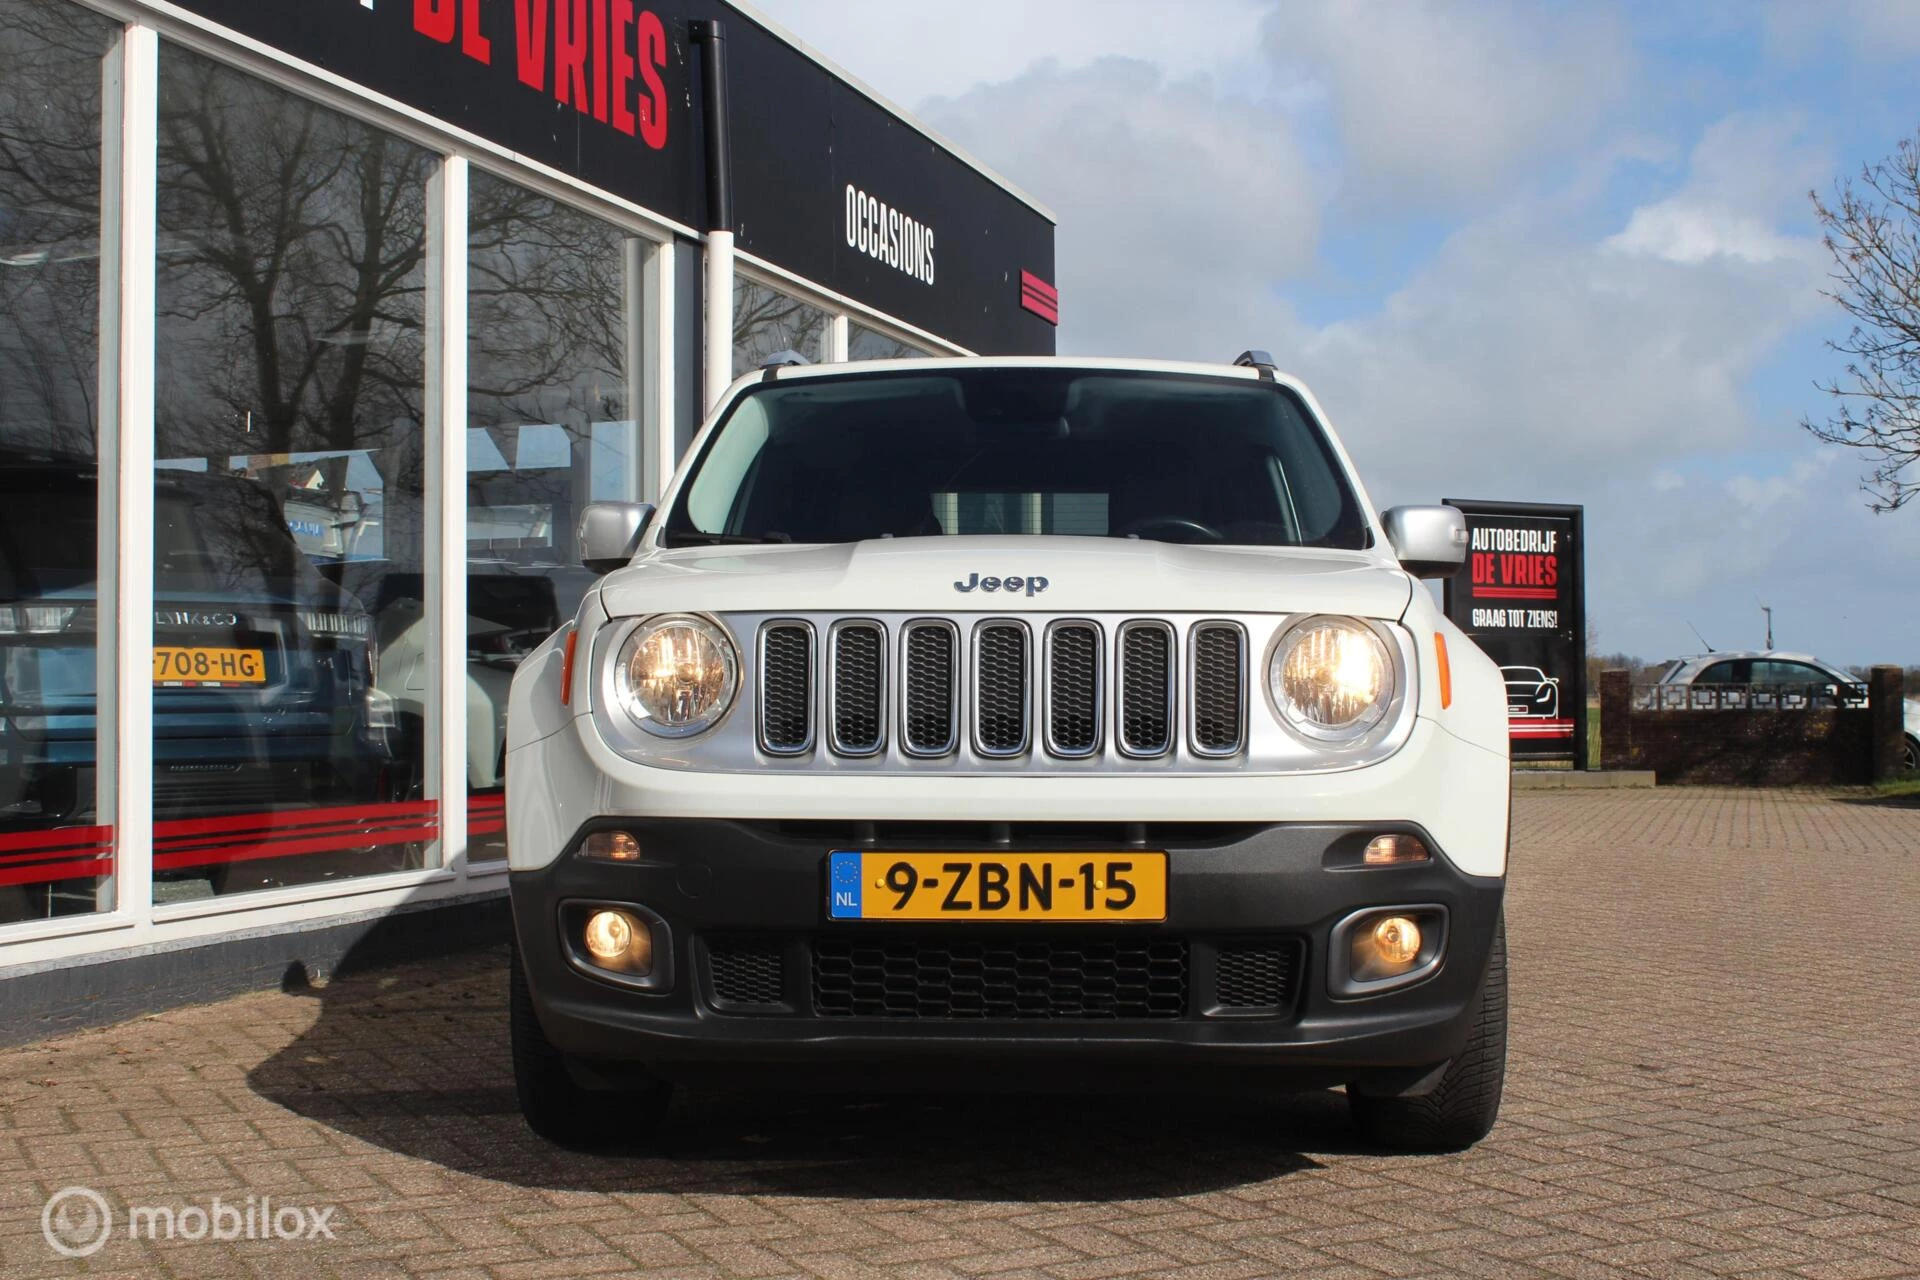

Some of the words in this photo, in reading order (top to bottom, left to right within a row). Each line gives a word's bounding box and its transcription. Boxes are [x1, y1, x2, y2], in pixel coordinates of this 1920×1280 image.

[514, 0, 668, 150] VRIES
[846, 184, 935, 286] OCCASIONS
[1472, 527, 1557, 553] AUTOBEDRIJF
[1472, 552, 1496, 584] DE
[1500, 553, 1557, 586] VRIES
[953, 572, 1050, 597] Jeep
[1472, 608, 1506, 628] GRAAG
[1507, 609, 1525, 628] TOT
[1527, 609, 1558, 629] ZIENS!
[836, 891, 857, 907] NL
[885, 861, 1137, 912] 9-ZBN-15
